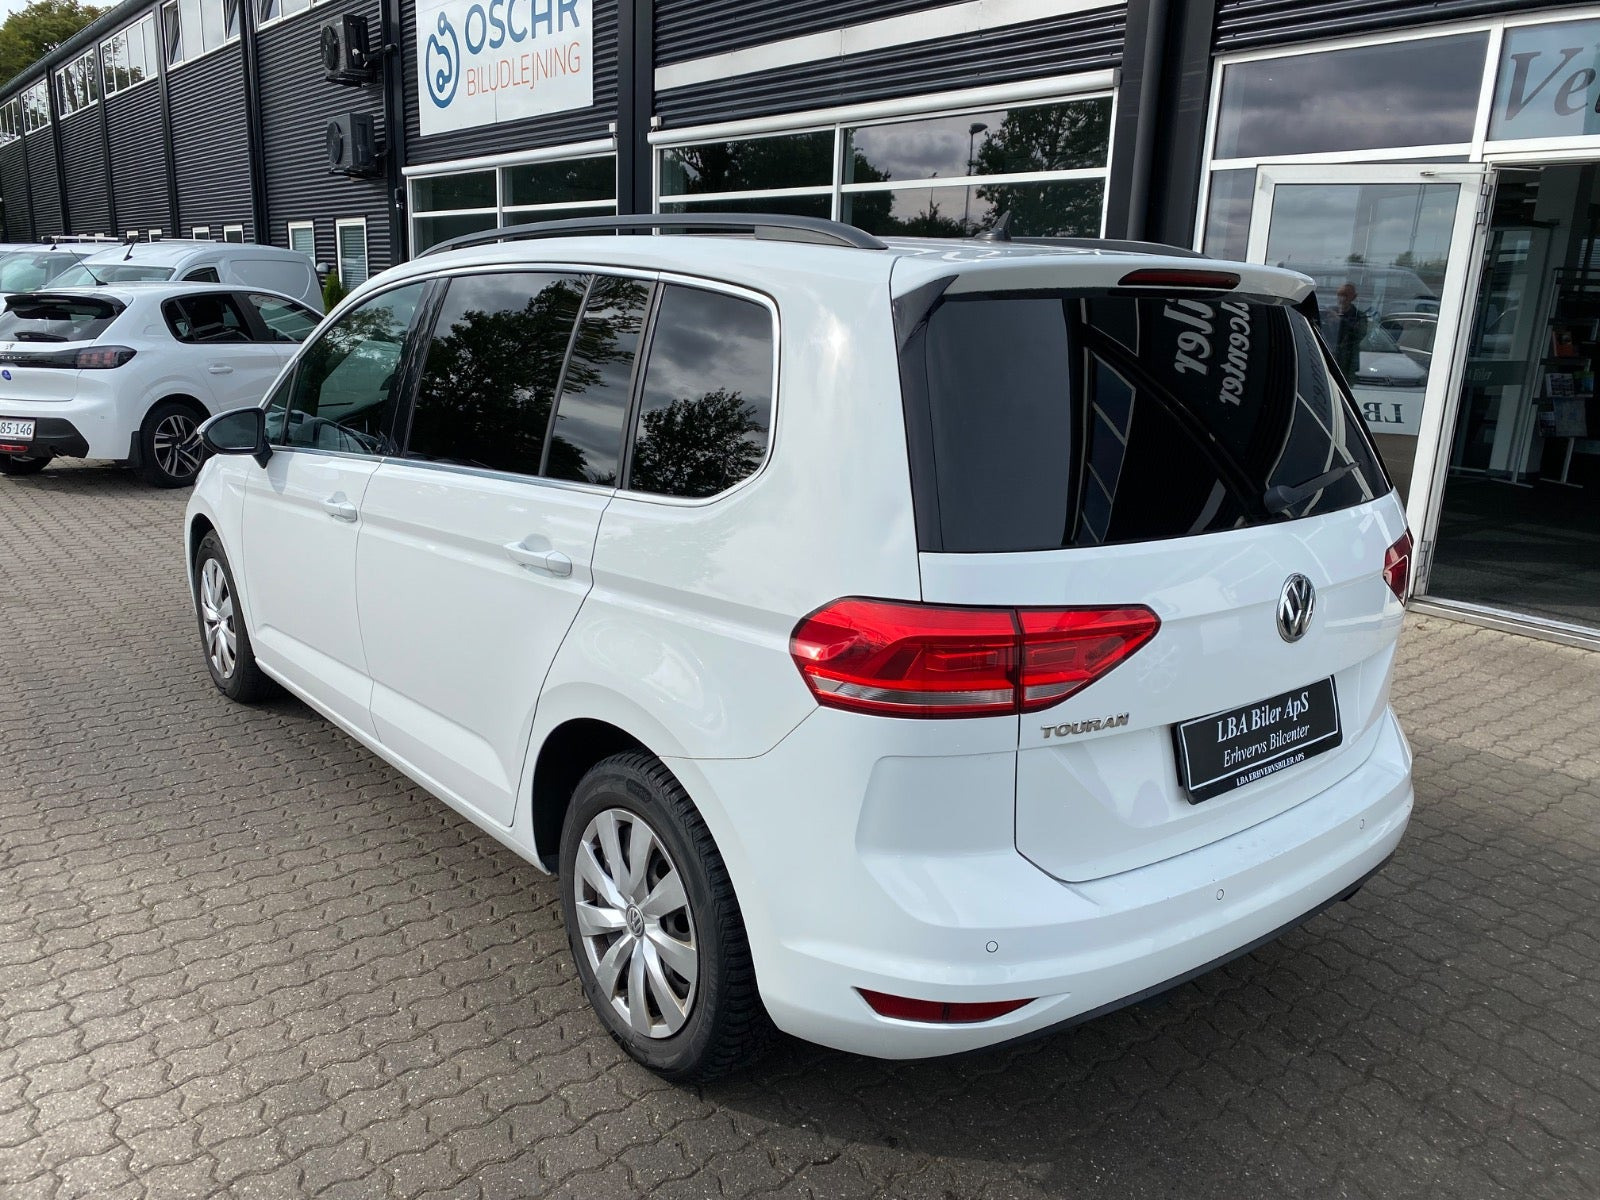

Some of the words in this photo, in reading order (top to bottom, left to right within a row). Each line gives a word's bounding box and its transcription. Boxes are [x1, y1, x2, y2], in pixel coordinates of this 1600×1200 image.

[466, 41, 581, 97] BILUDLEJNING
[1504, 42, 1600, 121] Ve
[14, 422, 32, 436] 146
[1040, 711, 1130, 739] TOURAN
[1216, 712, 1249, 743] LBA
[1250, 704, 1282, 731] Biler
[1283, 691, 1310, 721] ApS
[1223, 740, 1268, 768] Erhvervs
[1269, 723, 1310, 751] Bilcenter
[1236, 775, 1249, 787] LBA
[1294, 751, 1305, 765] APS
